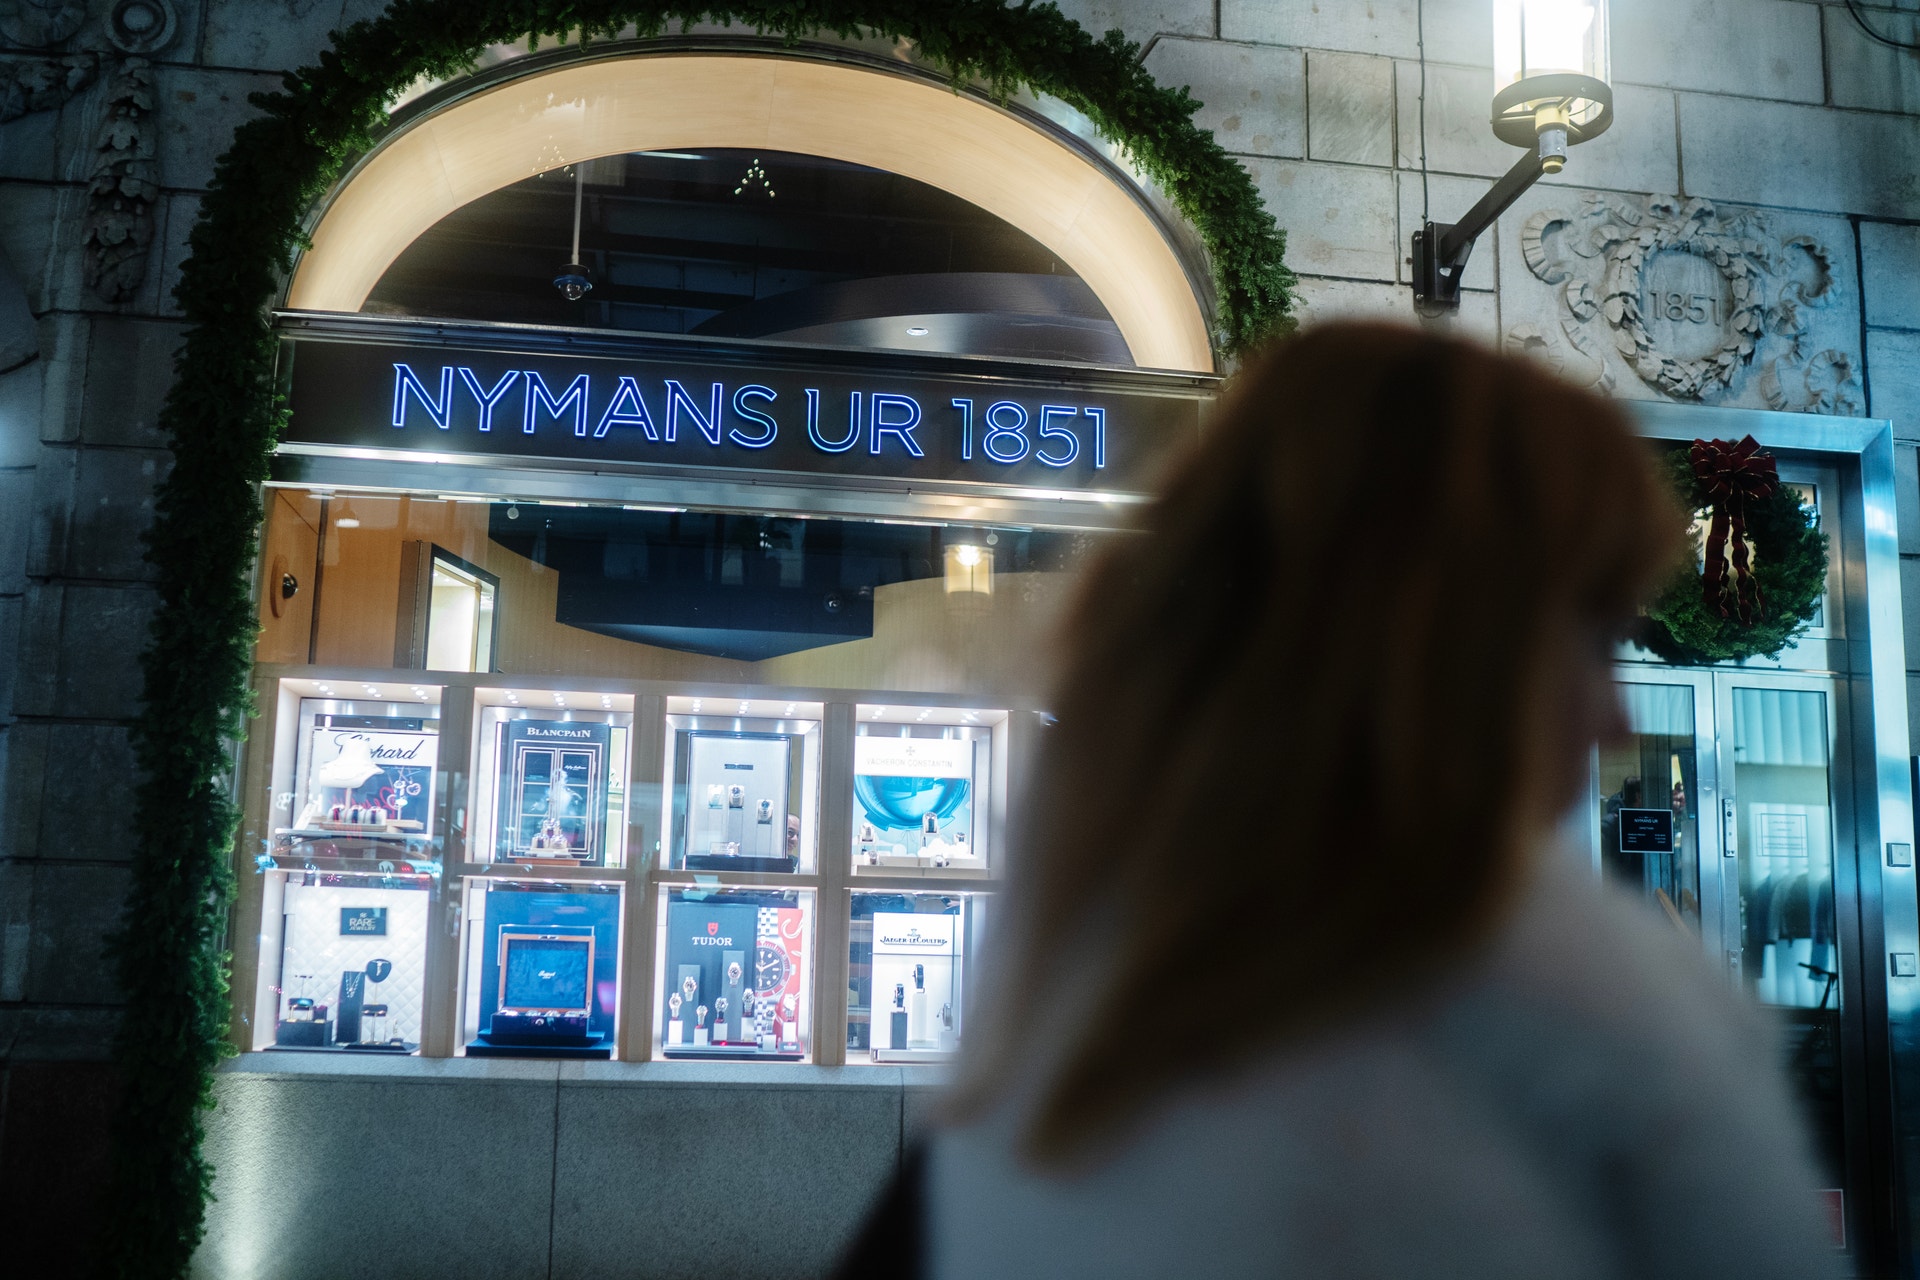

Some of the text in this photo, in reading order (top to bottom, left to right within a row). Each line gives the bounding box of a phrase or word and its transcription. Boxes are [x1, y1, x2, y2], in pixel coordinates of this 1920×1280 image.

[1649, 290, 1722, 327] 1851
[393, 363, 1106, 469] NYMANS UR 1851
[526, 727, 593, 738] BLANCPAIN
[691, 936, 733, 946] TUDOR
